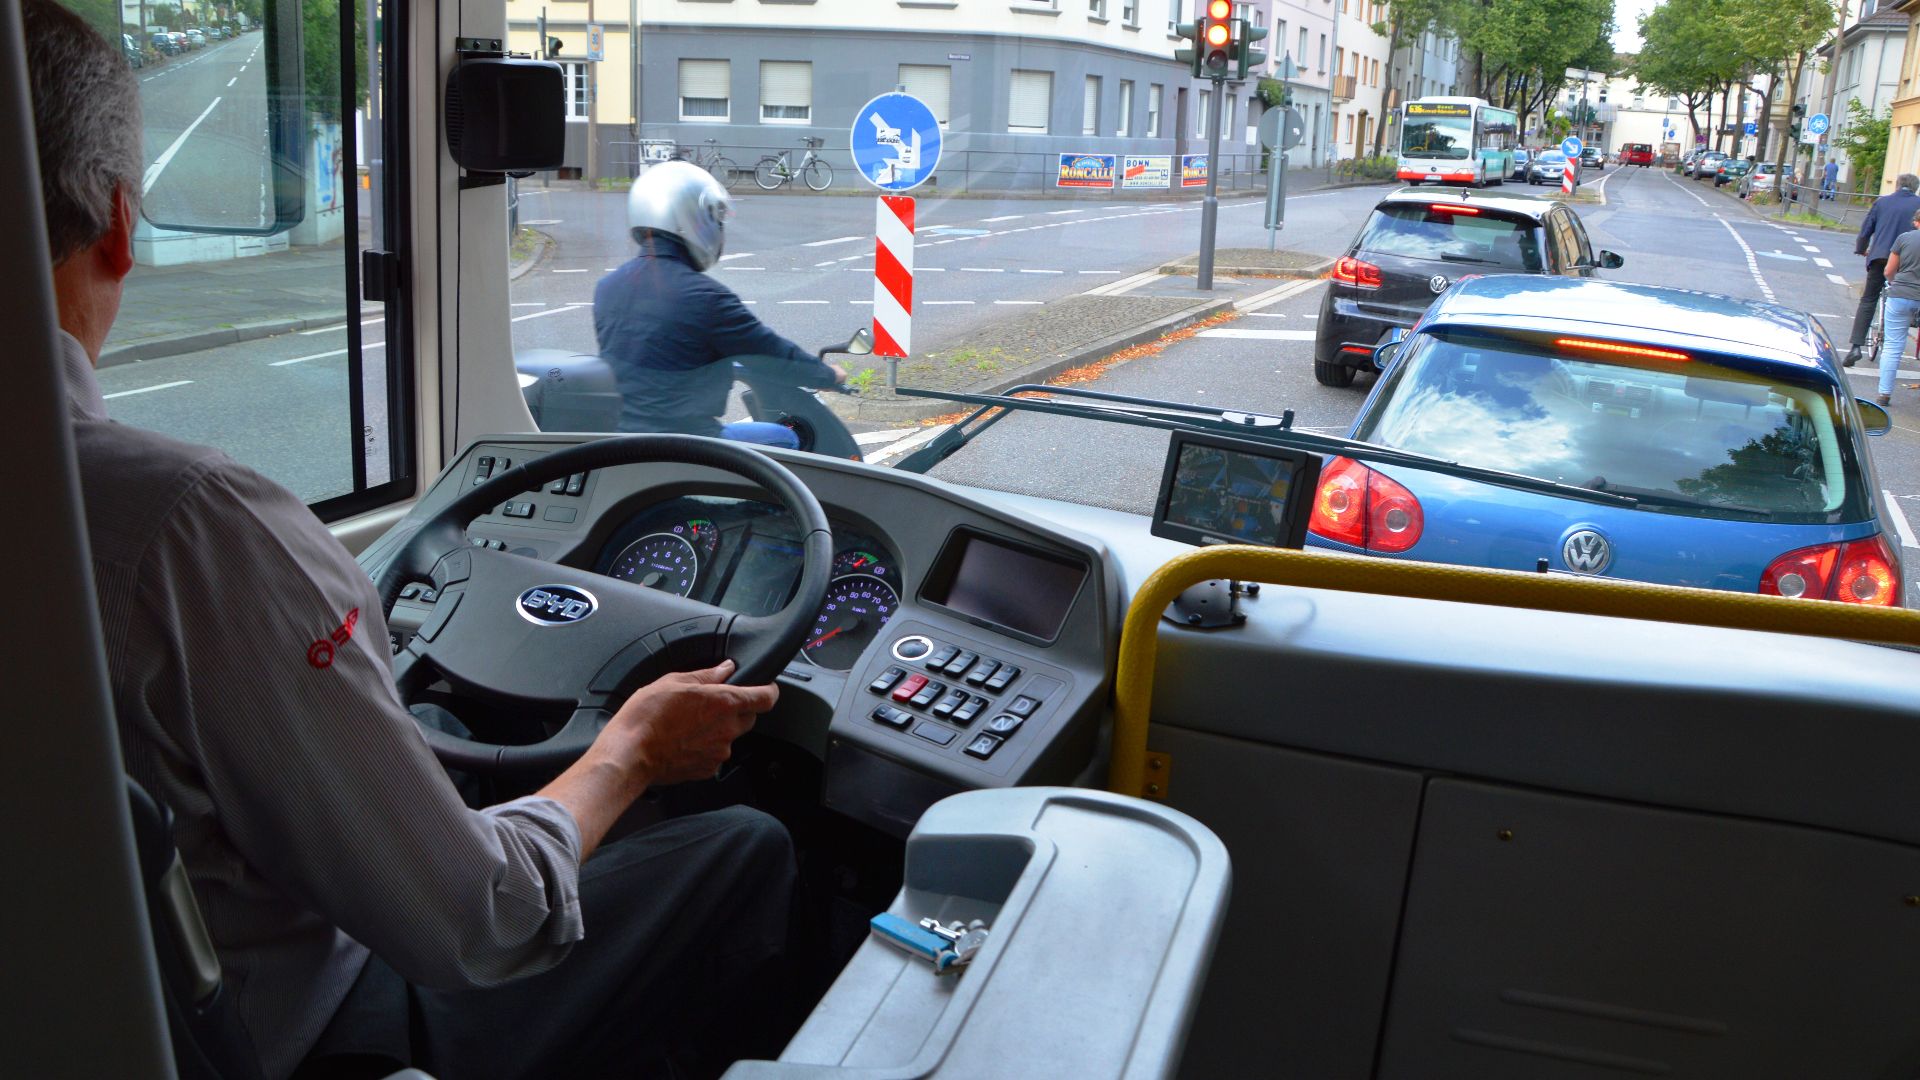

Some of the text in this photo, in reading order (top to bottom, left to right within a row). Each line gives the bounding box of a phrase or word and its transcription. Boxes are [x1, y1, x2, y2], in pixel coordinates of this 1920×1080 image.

[1126, 159, 1150, 168] BONN
[1060, 164, 1115, 179] RONCALLI
[522, 589, 589, 619] BYD
[1015, 698, 1030, 711] D
[993, 716, 1013, 730] N
[974, 737, 991, 752] R
